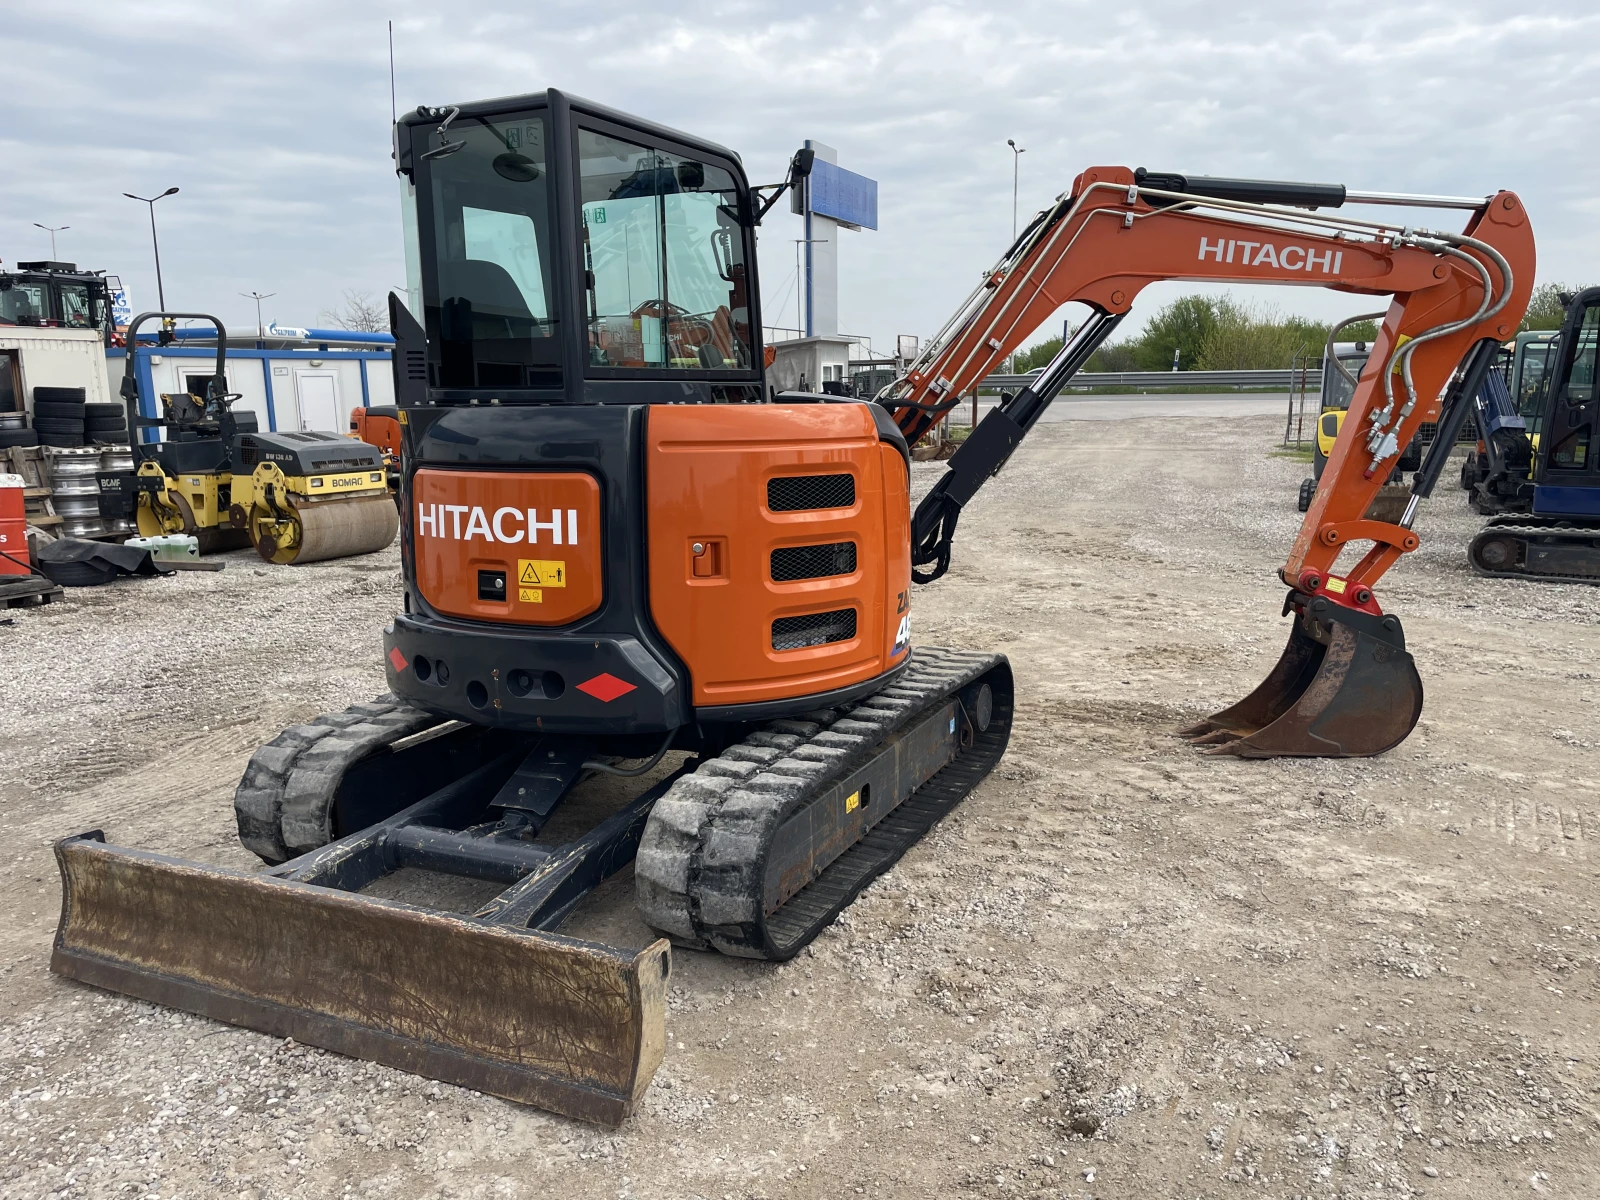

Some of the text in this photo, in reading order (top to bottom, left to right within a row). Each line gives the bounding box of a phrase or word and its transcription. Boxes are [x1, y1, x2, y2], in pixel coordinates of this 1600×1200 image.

[1198, 237, 1343, 275] HITACHI
[332, 477, 363, 487] BOMAG
[418, 503, 578, 545] HITACHI
